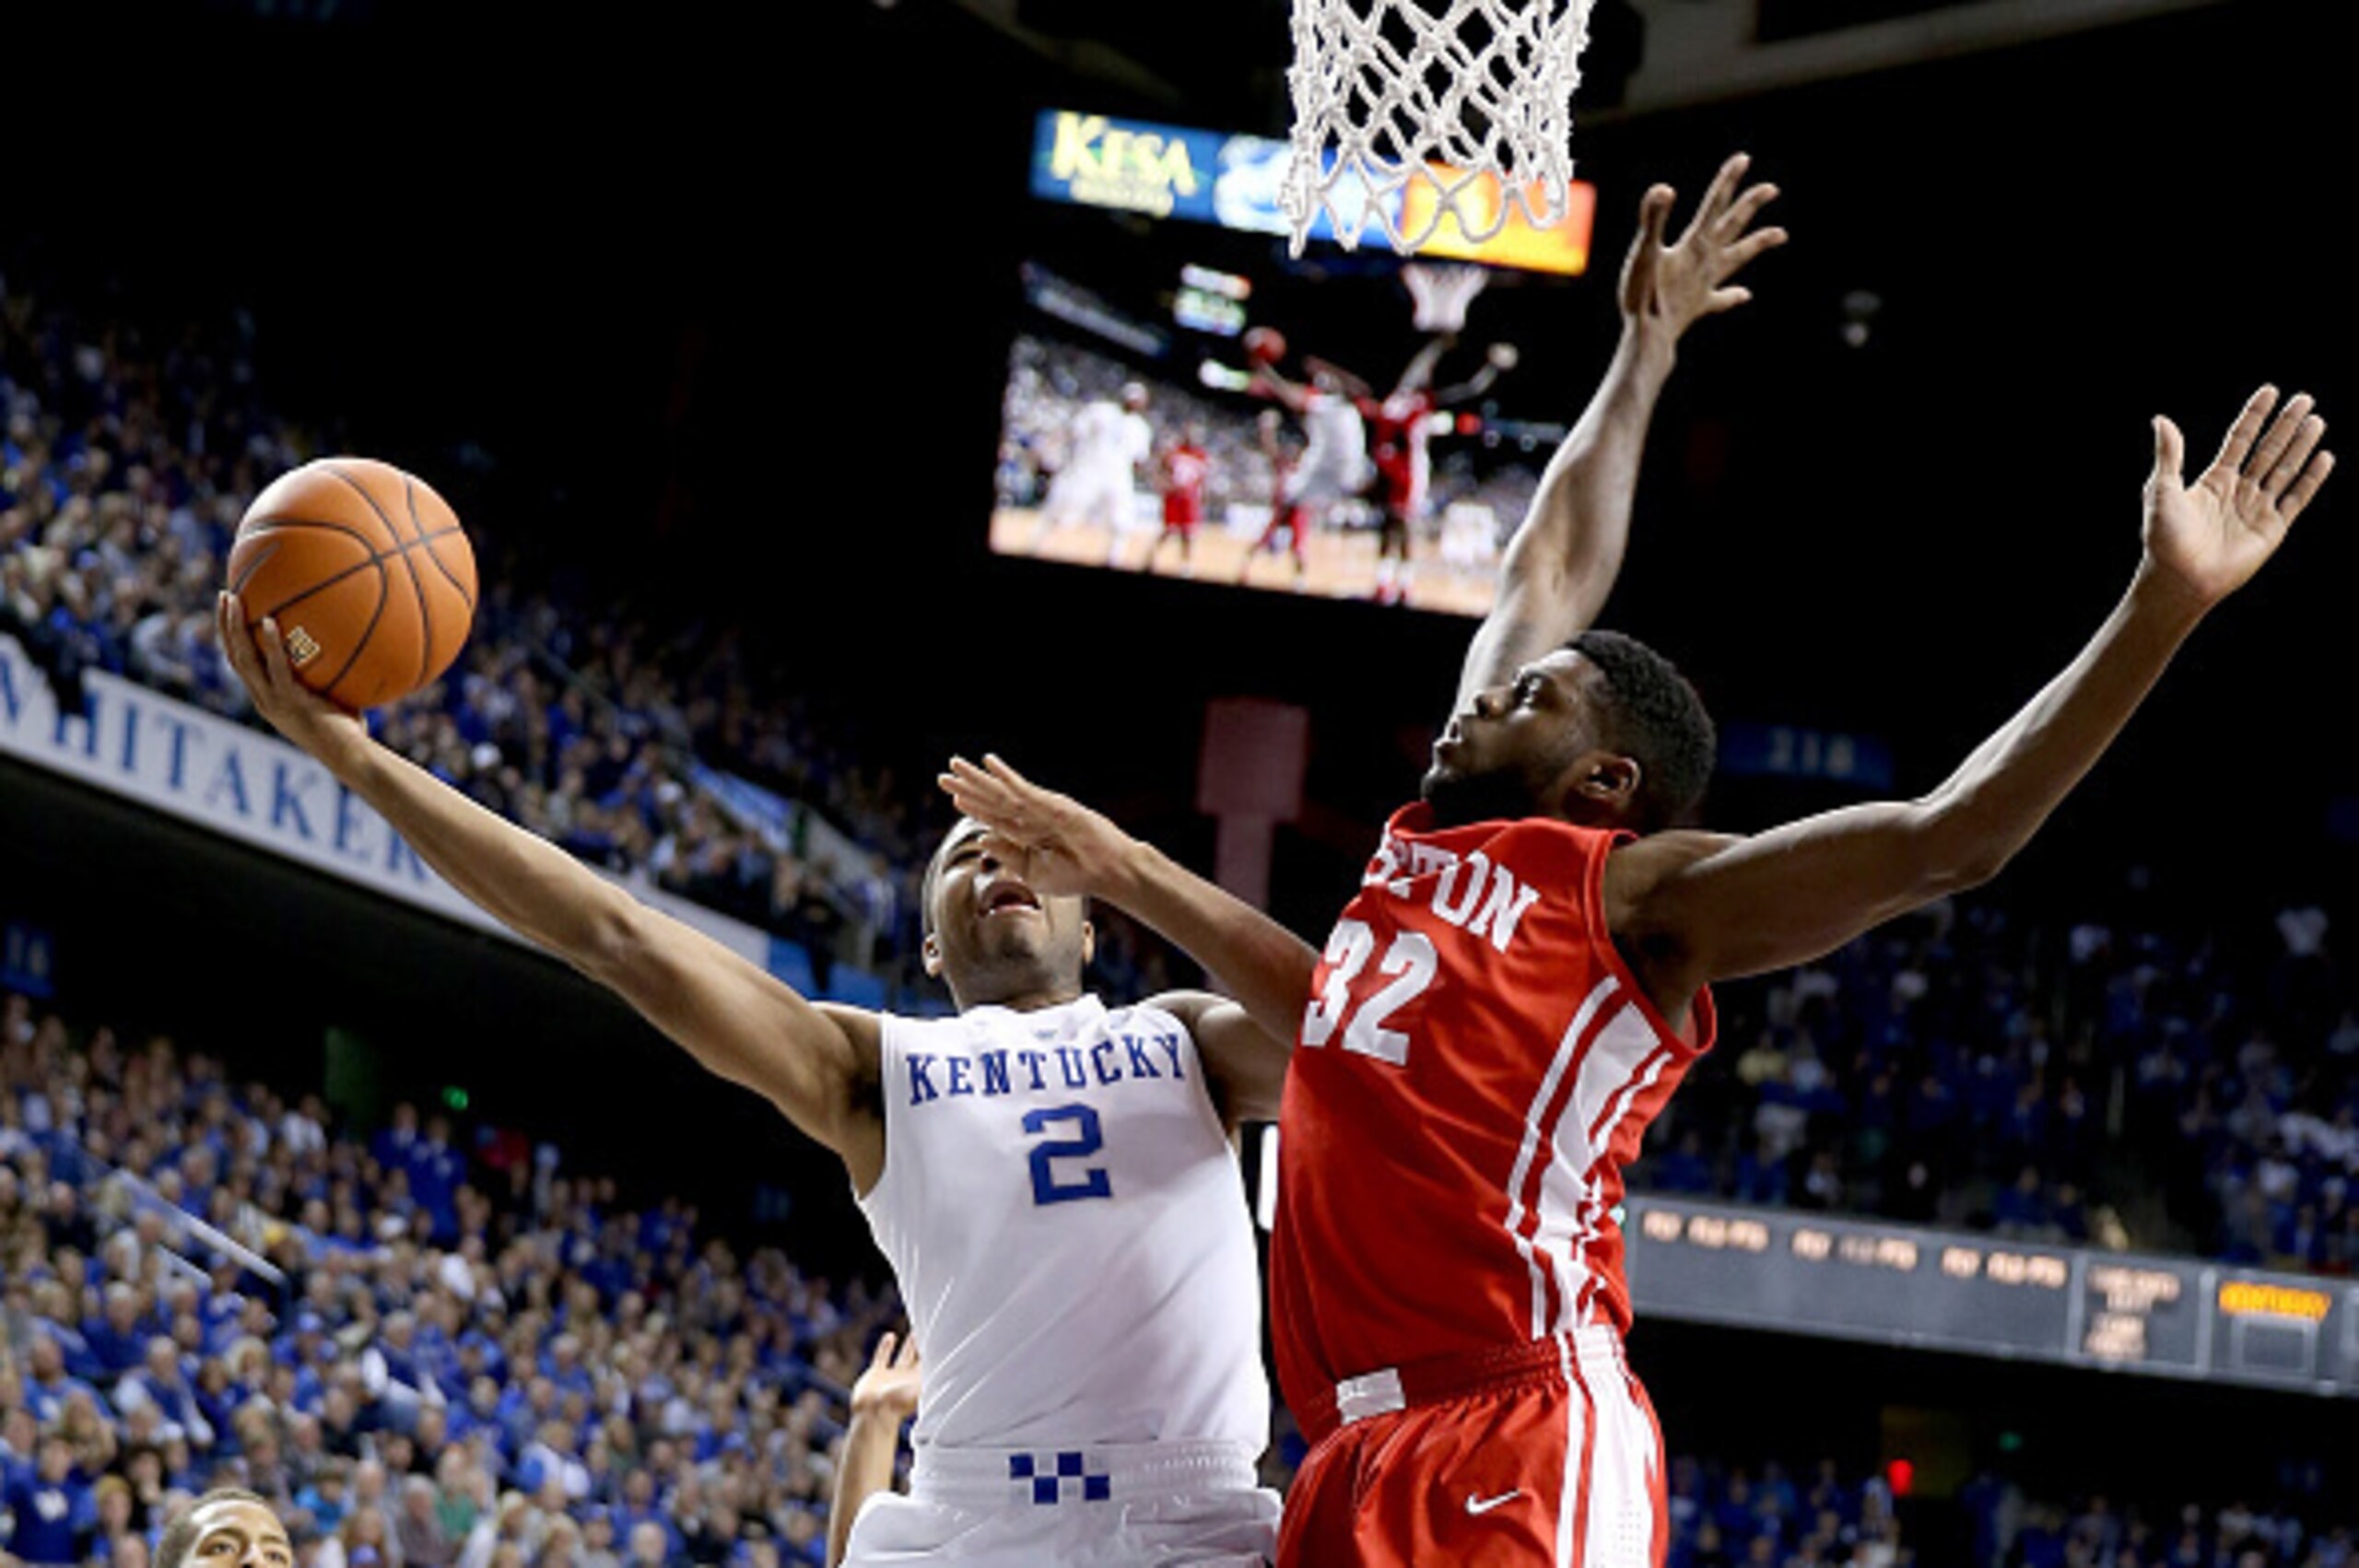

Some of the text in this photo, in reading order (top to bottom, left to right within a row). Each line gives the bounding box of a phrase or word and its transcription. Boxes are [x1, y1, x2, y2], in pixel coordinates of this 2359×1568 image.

[1300, 919, 1439, 1067] 32
[906, 1034, 1185, 1106] KENTUCKY
[1021, 1102, 1113, 1207] 2
